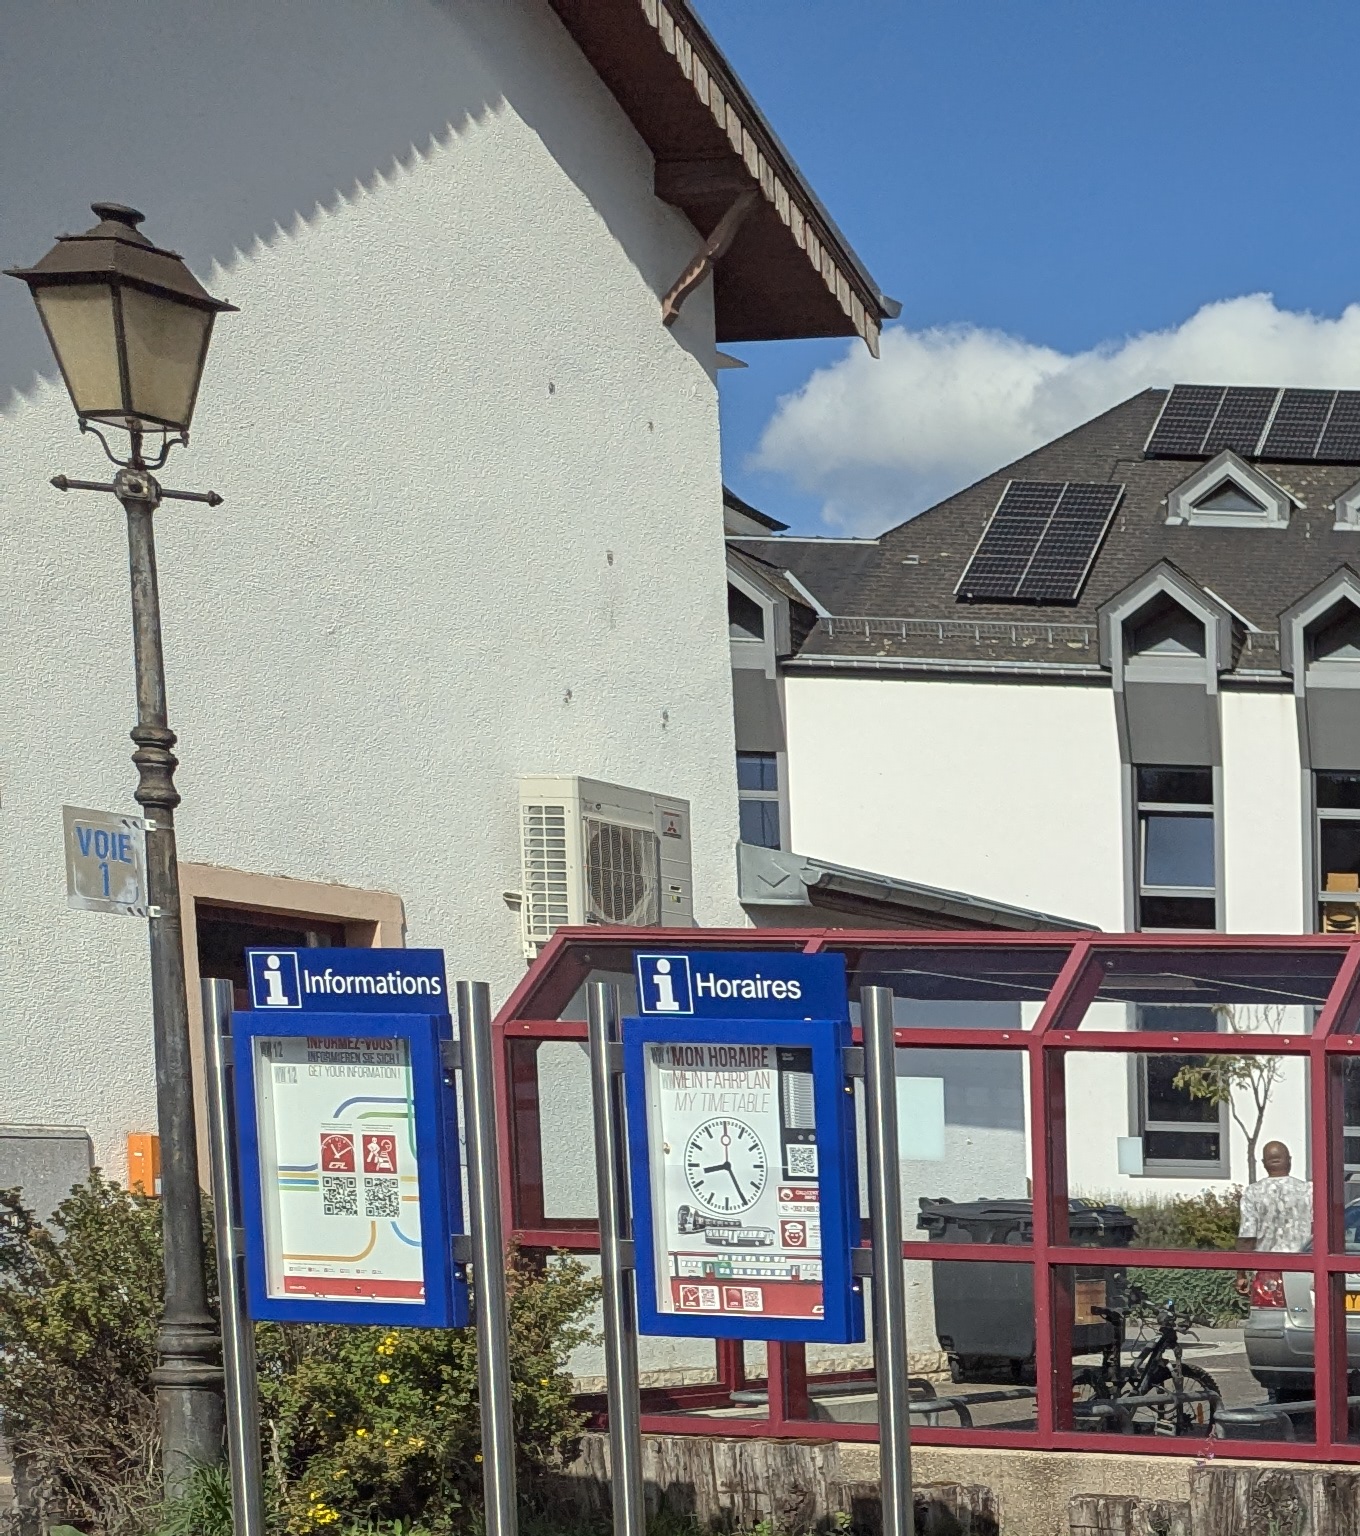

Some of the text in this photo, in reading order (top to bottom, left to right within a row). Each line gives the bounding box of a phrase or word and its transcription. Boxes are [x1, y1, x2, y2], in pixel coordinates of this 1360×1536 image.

[75, 826, 132, 864] VOIE
[98, 861, 110, 897] 1
[303, 968, 442, 995] Informations
[695, 972, 802, 1000] Horaires
[670, 1045, 705, 1067] MON
[708, 1046, 770, 1068] HORAIRE
[308, 1064, 323, 1077] GET
[324, 1065, 346, 1078] YOUR
[672, 1070, 771, 1090] MEIN FAHRPLAN
[674, 1091, 771, 1113] MY TIMETABLE
